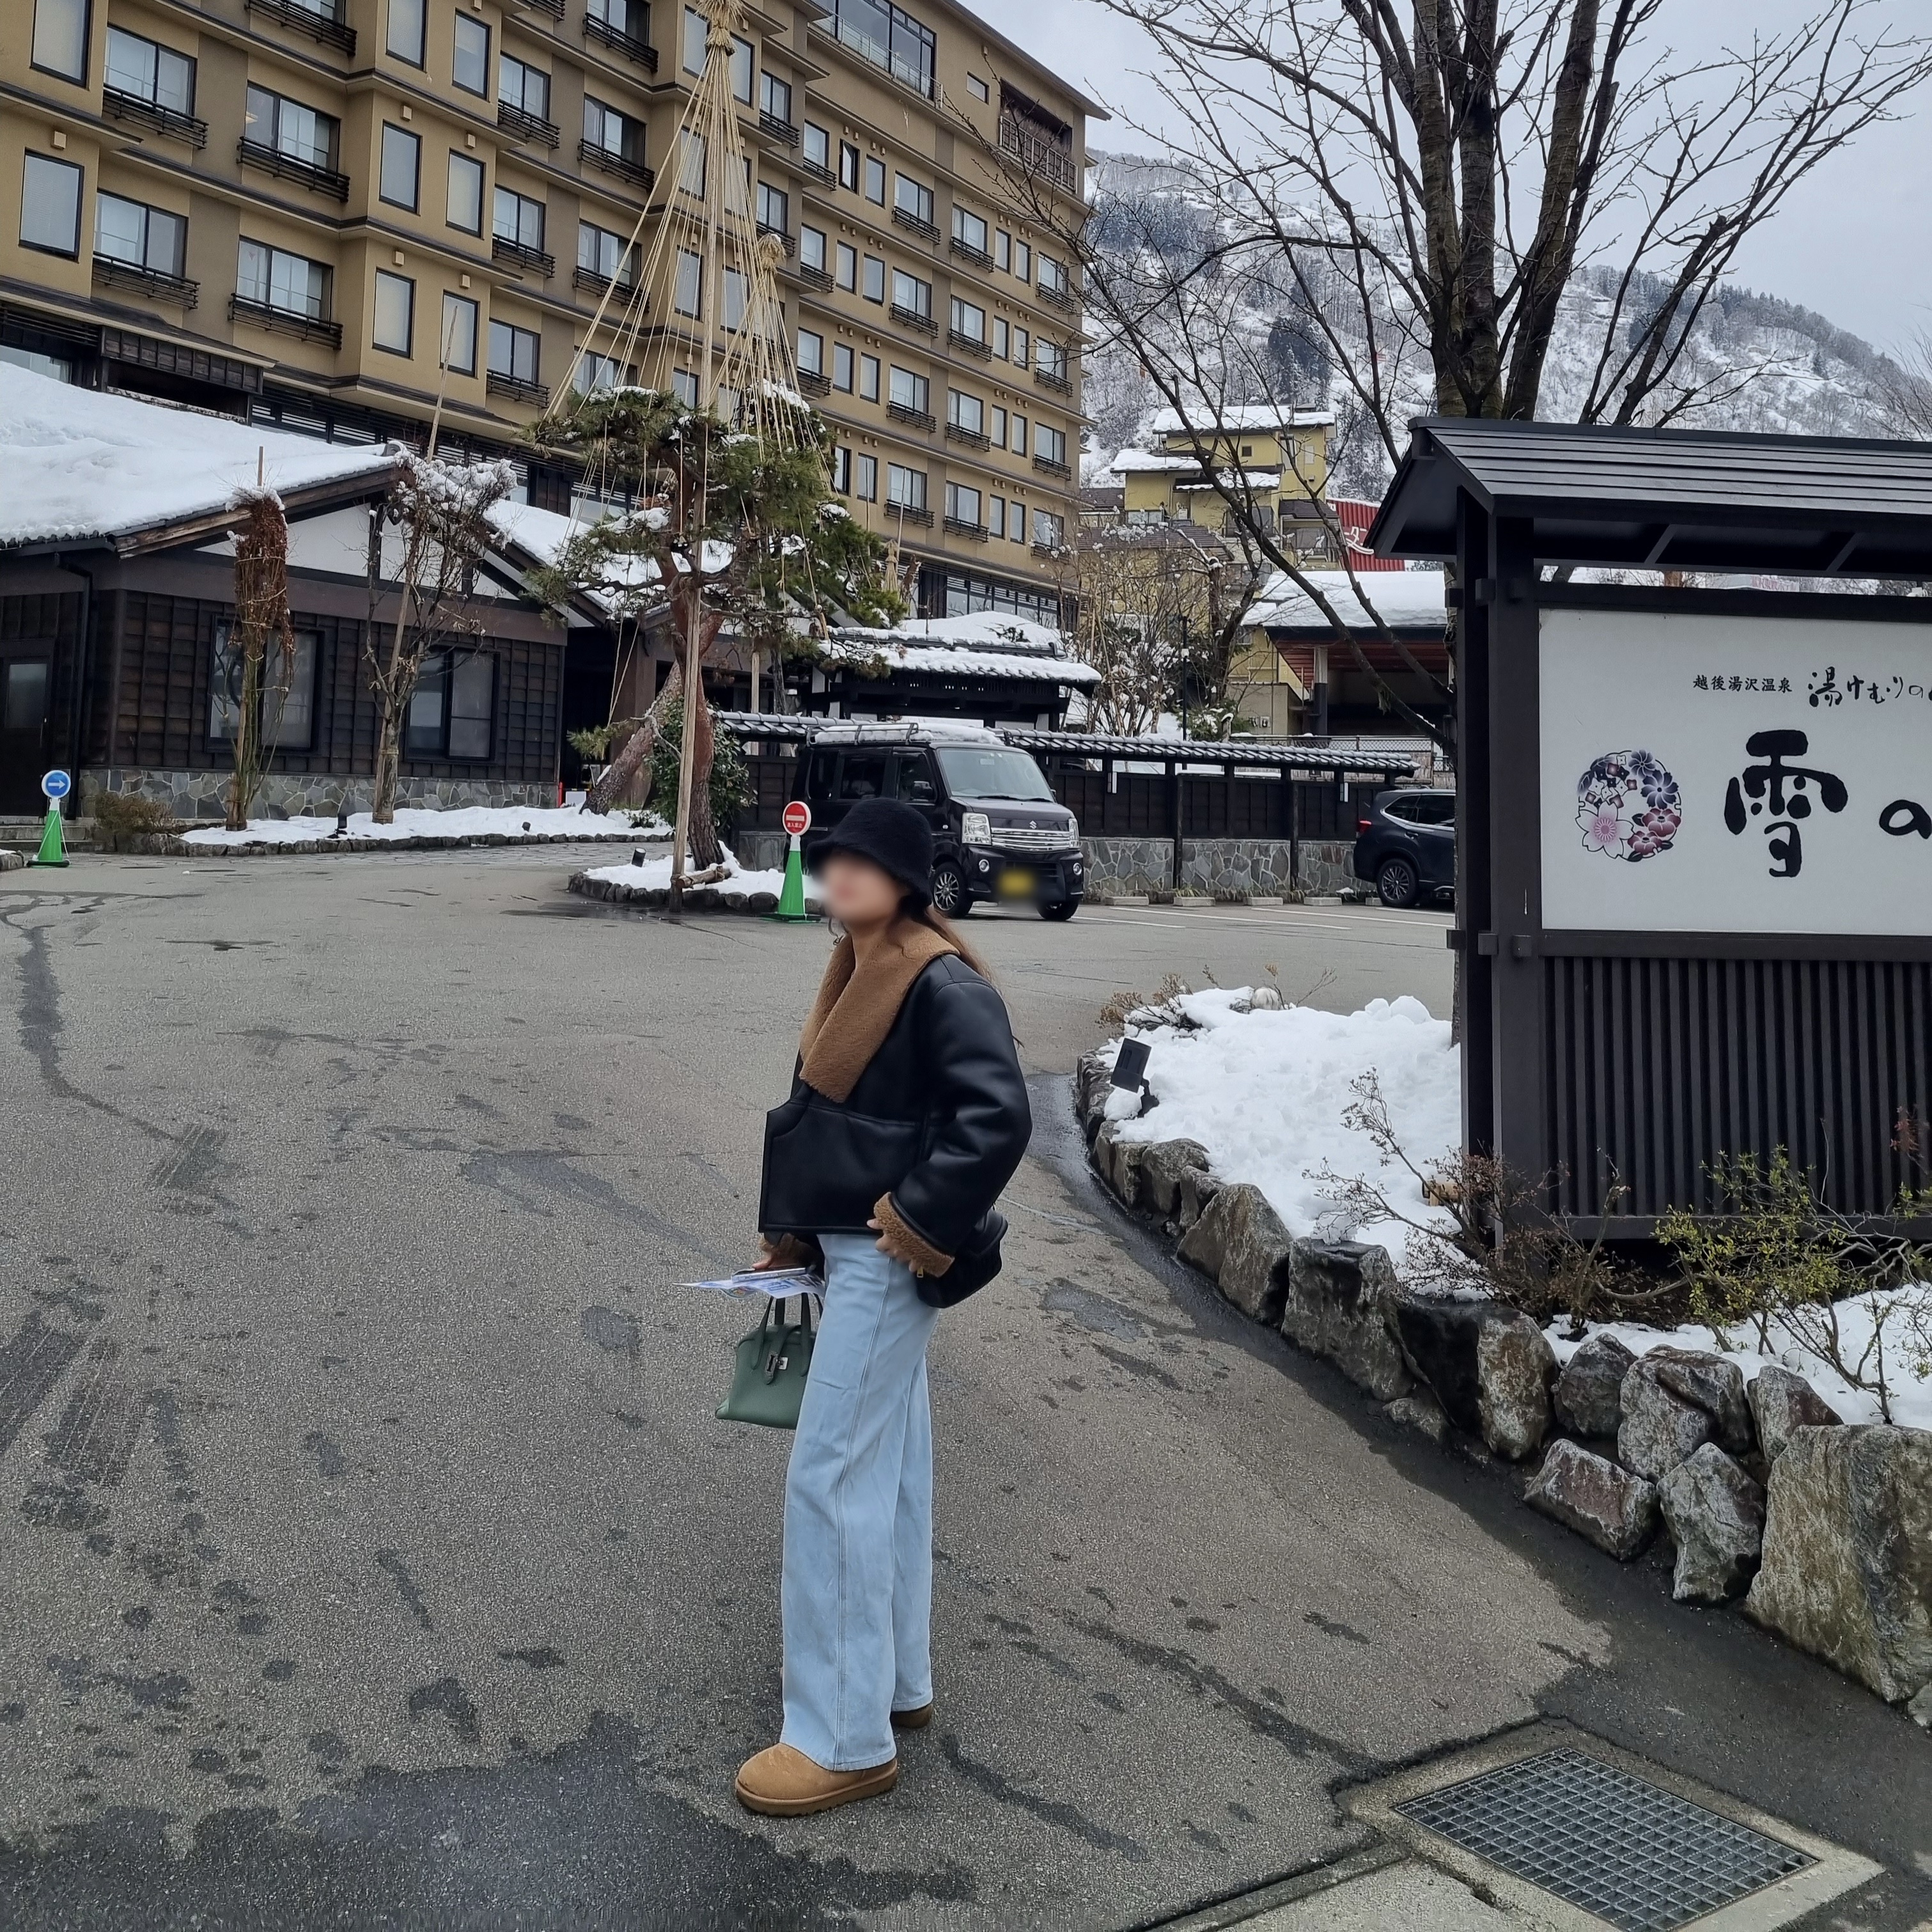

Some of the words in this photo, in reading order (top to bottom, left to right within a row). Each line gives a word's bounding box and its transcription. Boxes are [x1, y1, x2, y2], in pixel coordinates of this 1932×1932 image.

[1692, 674, 1793, 694] 越後湯沢温泉
[1807, 666, 1932, 708] 湯けむりの
[1724, 729, 1932, 878] 雪の
